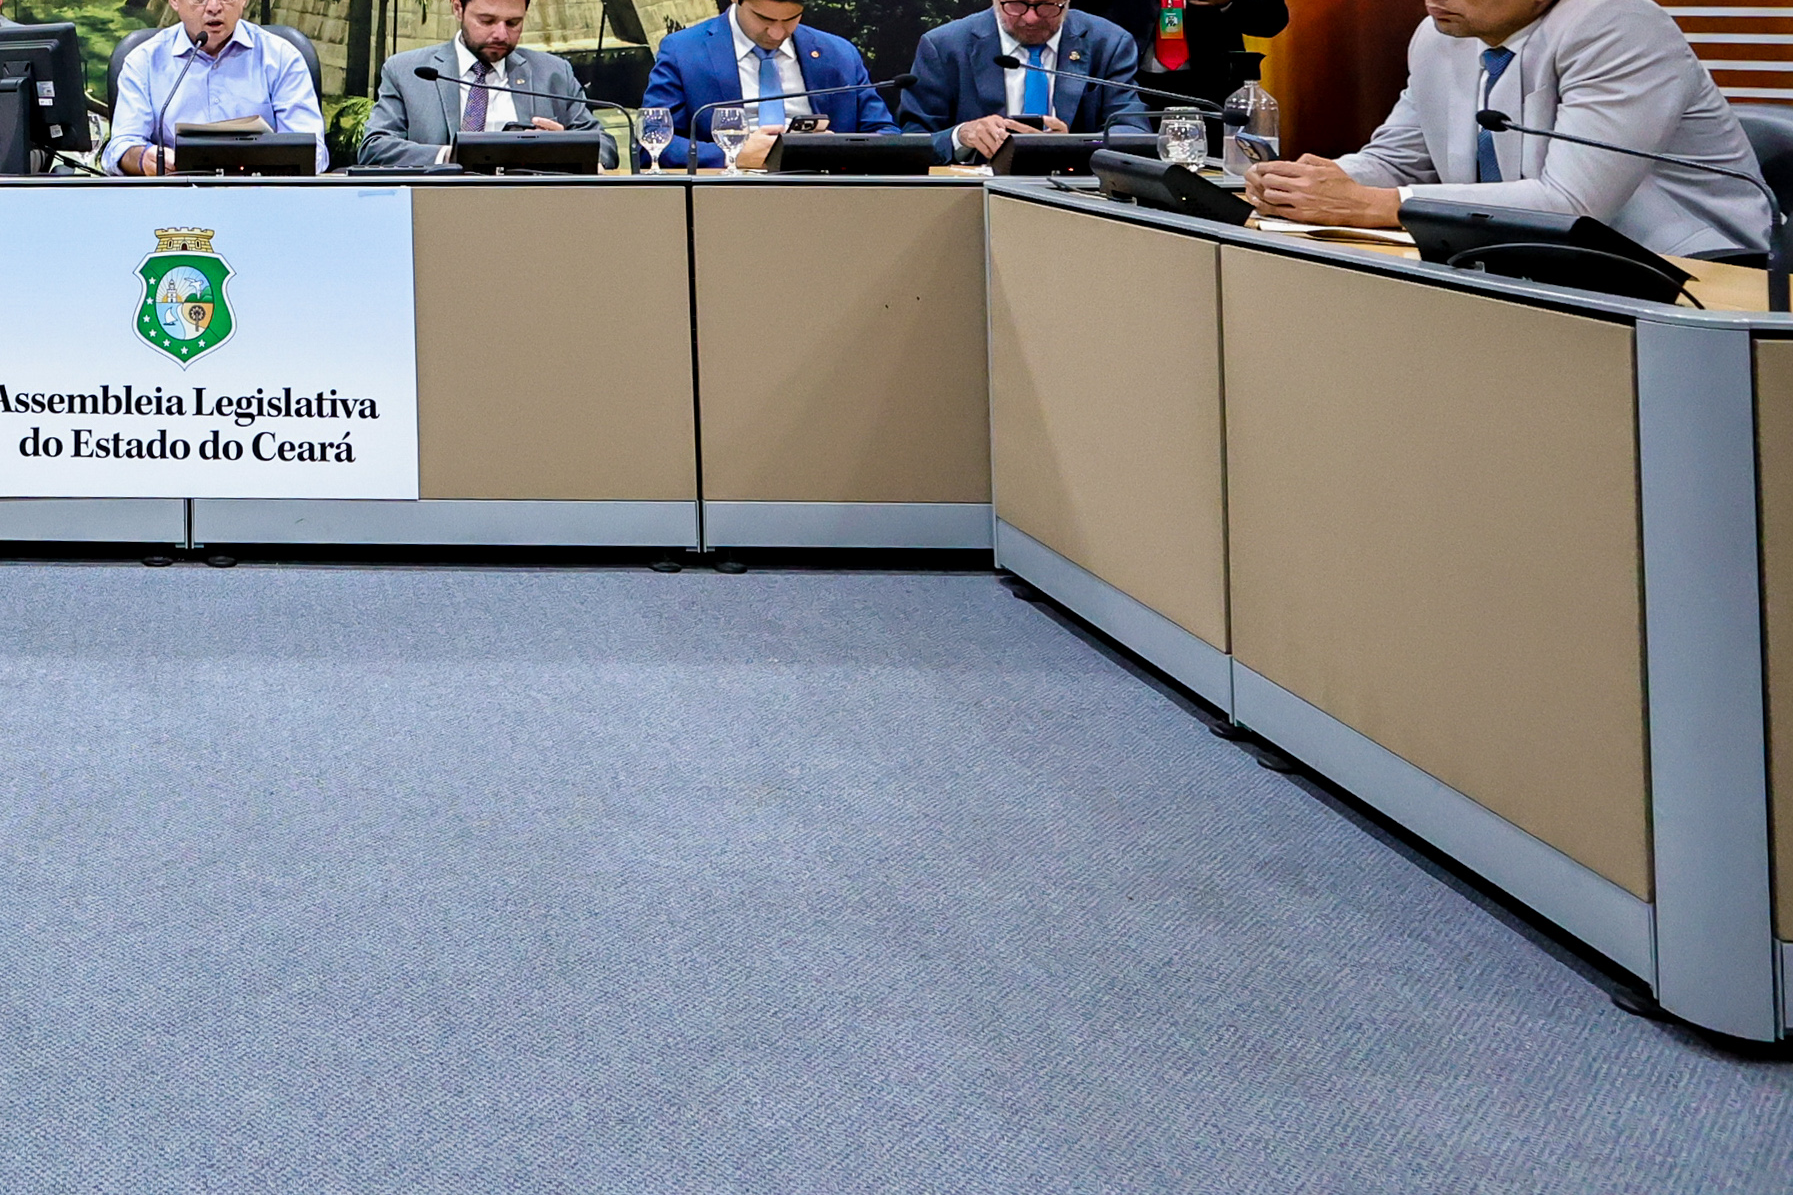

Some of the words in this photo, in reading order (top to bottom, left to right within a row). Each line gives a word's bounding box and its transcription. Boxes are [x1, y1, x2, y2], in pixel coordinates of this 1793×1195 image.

[192, 387, 380, 427] Legislativa
[19, 427, 63, 458] do
[71, 429, 191, 460] Estado
[198, 430, 244, 461] do
[252, 431, 356, 463] Ceará
